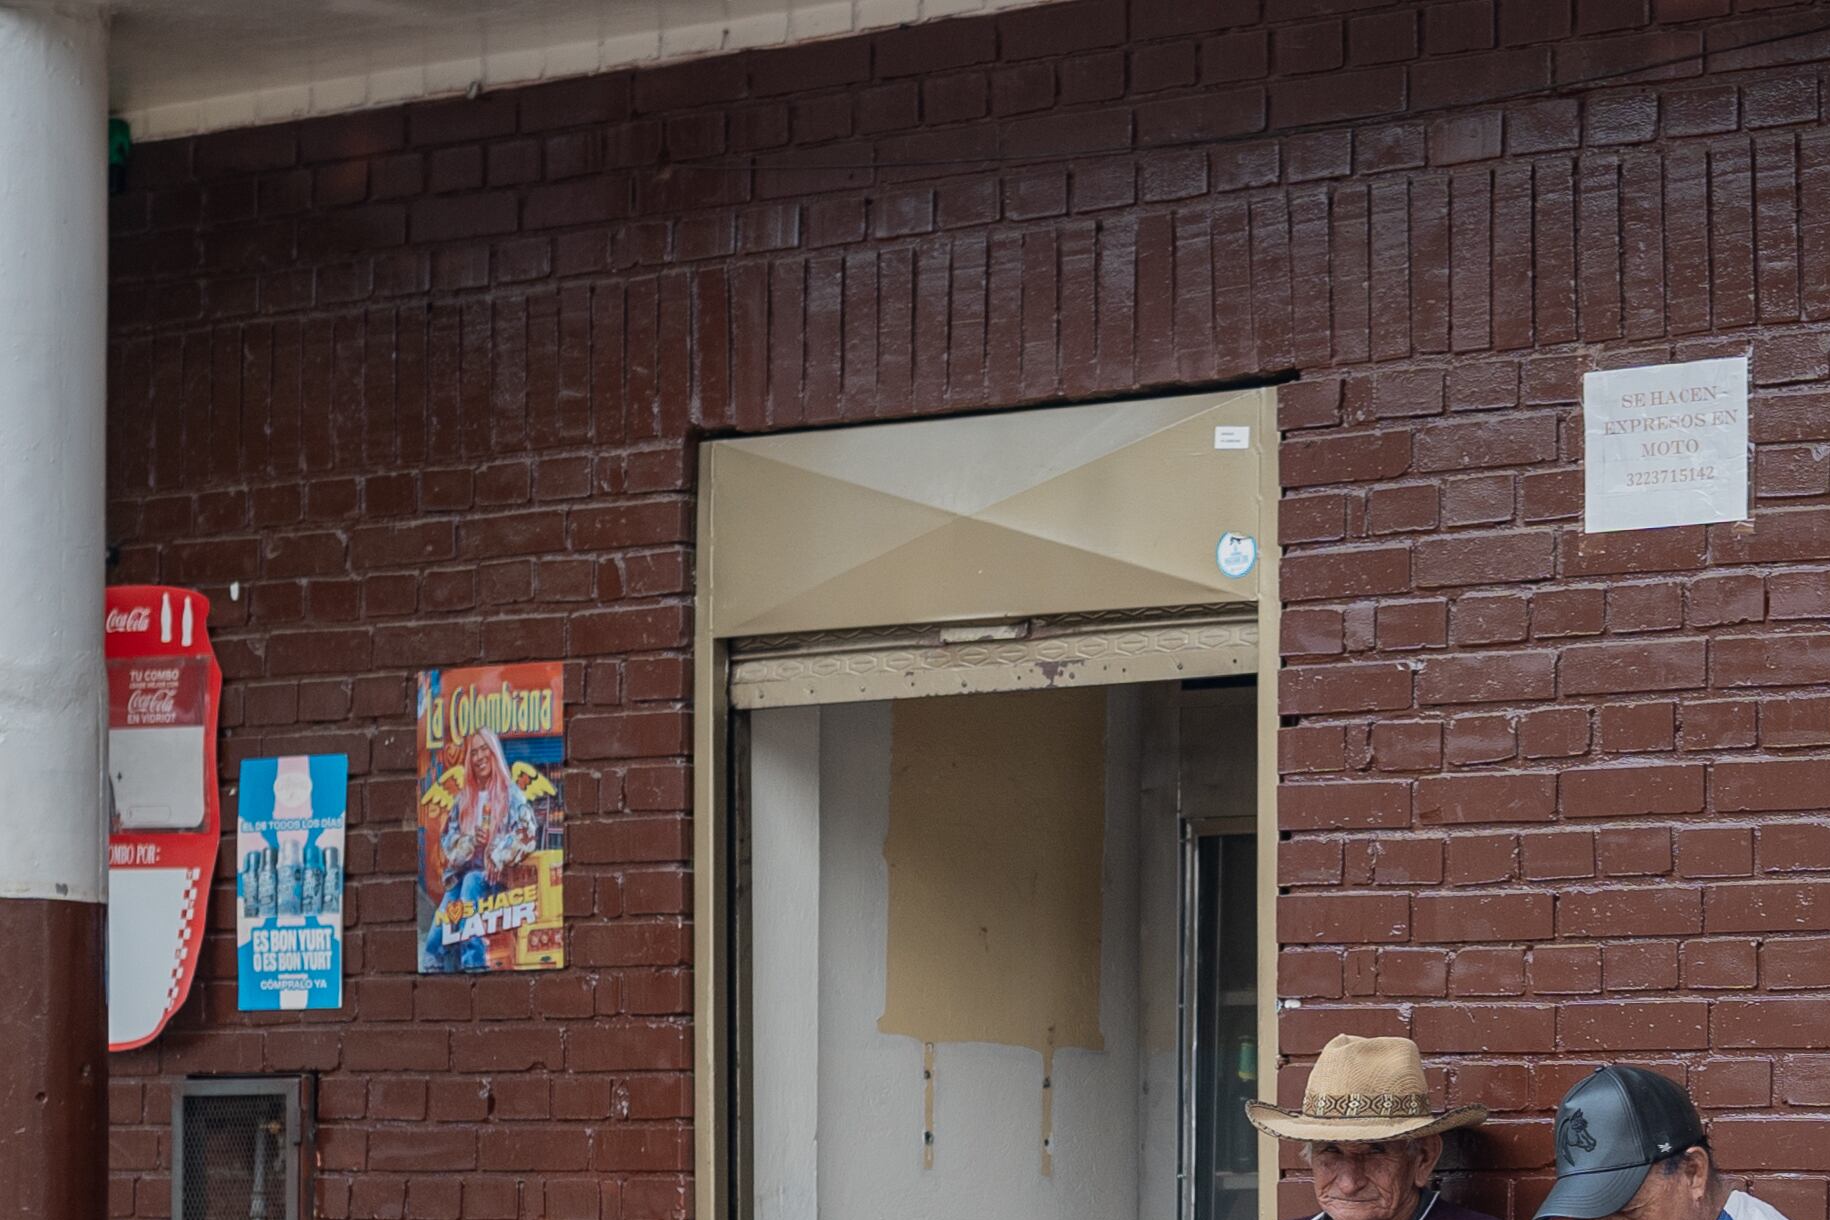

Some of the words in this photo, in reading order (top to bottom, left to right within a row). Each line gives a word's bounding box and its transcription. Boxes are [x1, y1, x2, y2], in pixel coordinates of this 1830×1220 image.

[1621, 392, 1646, 409] SE
[1649, 385, 1718, 406] HACEN
[1603, 414, 1707, 436] EXPRESOS
[1712, 408, 1739, 426] EN
[1640, 438, 1700, 458] MOTO
[1625, 466, 1715, 487] 3223715142
[105, 606, 151, 633] Coca-Cola
[130, 670, 143, 681] TU
[144, 668, 179, 681] COMBO
[127, 688, 178, 713] Coca-Cola
[127, 714, 141, 724] EN
[425, 686, 445, 749] La
[449, 681, 553, 746] Colombiana
[269, 818, 300, 831] TODOS
[302, 818, 320, 830] LOS
[108, 843, 135, 865] OMBO
[477, 884, 538, 914] HACE
[441, 901, 537, 946] LATIR
[252, 929, 270, 953] ES
[270, 928, 298, 952] BON
[298, 927, 333, 951] YURT
[252, 953, 262, 973] O
[263, 952, 277, 972] ES
[278, 951, 302, 972] BON
[302, 950, 333, 970] YURT
[314, 979, 328, 989] YA
